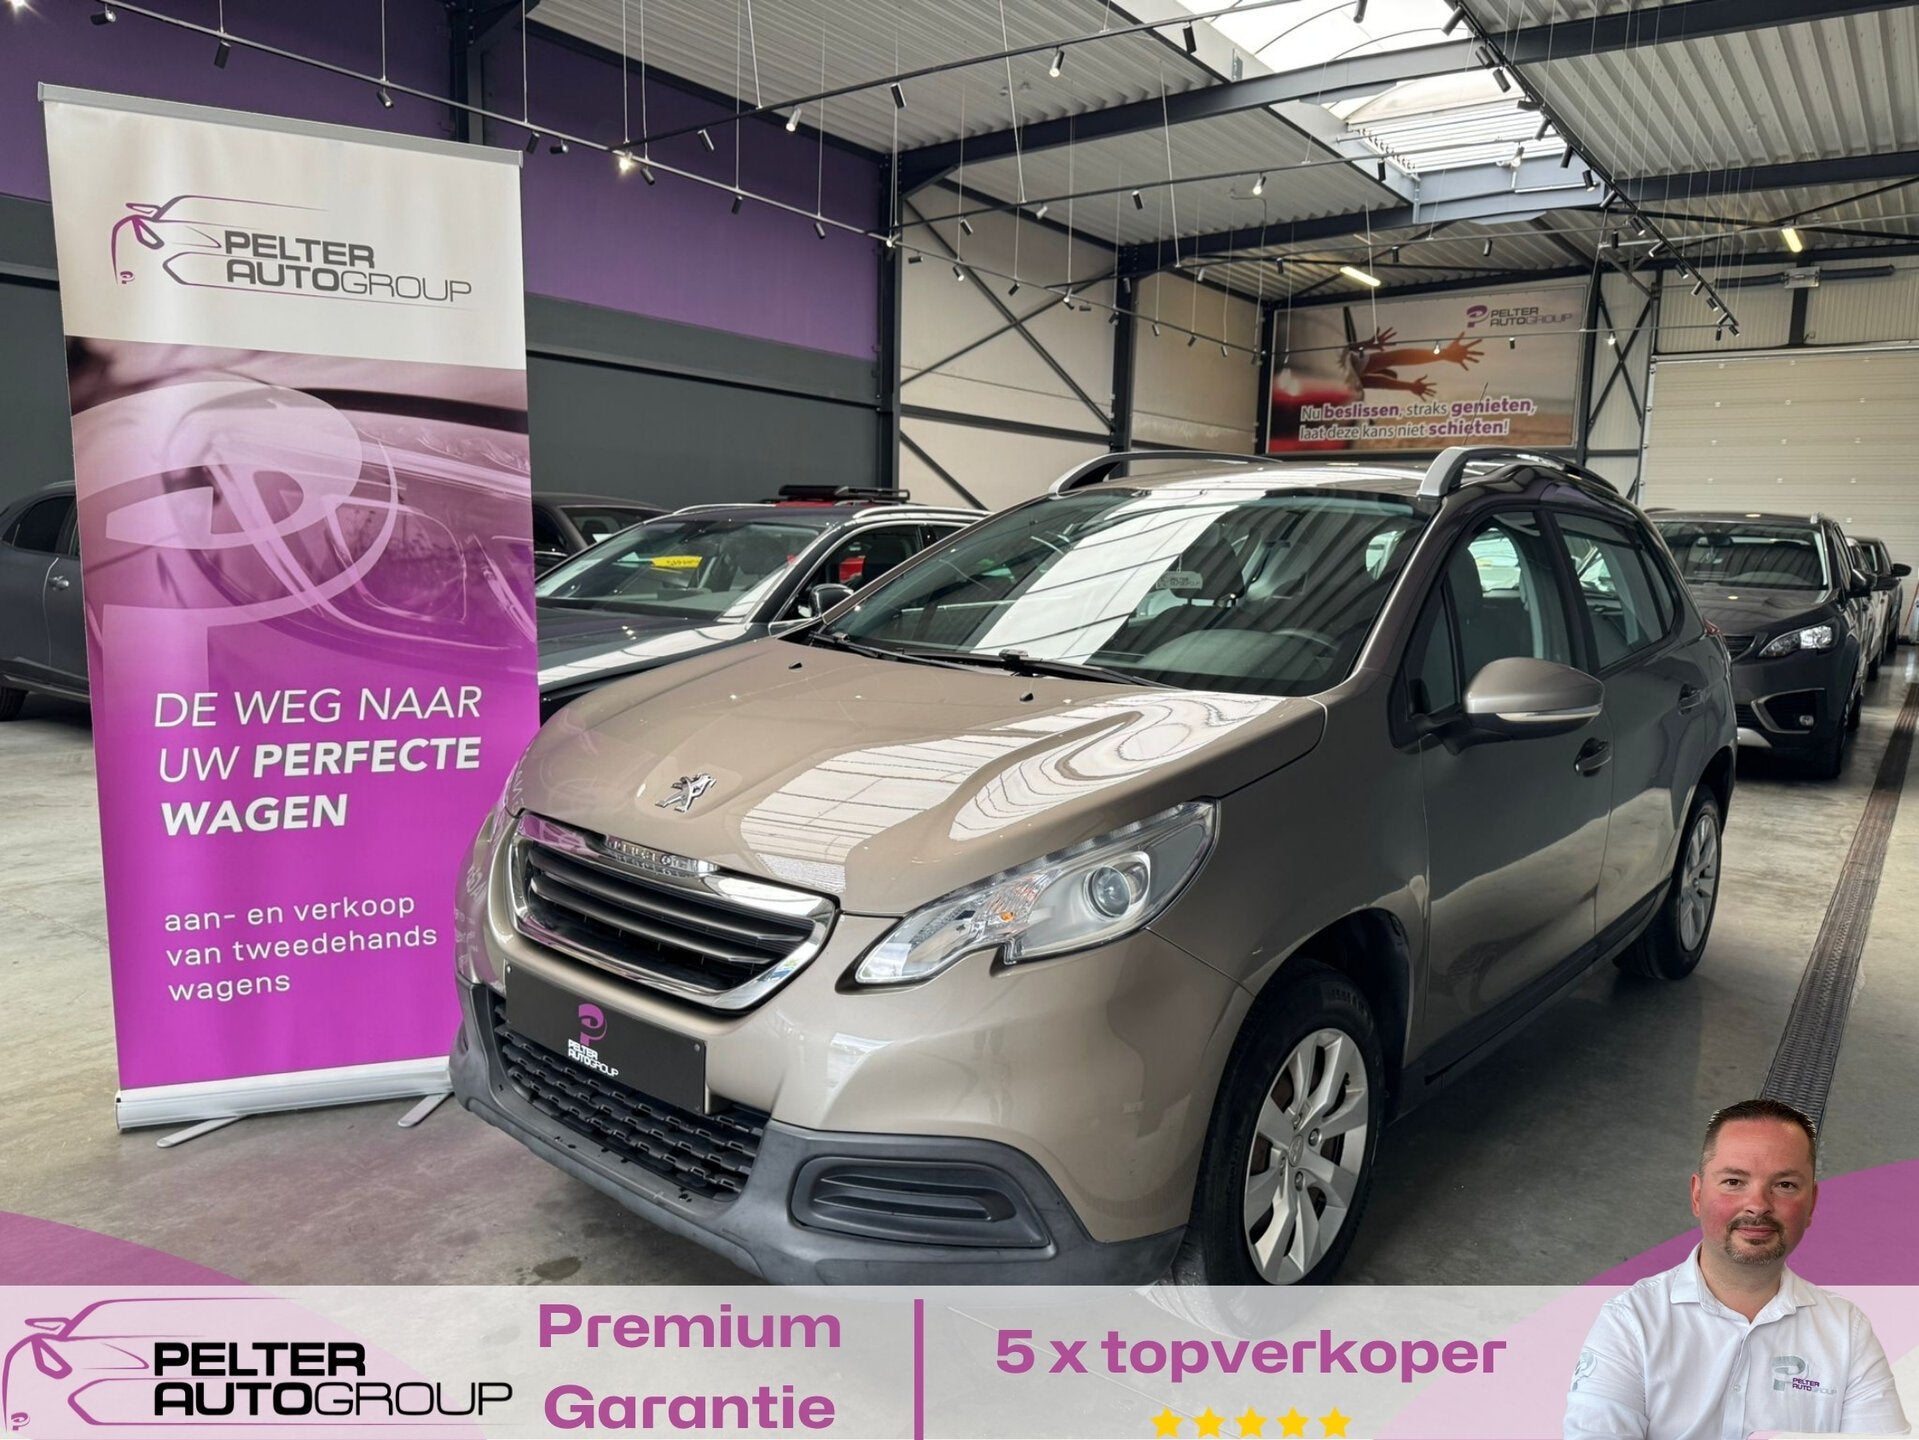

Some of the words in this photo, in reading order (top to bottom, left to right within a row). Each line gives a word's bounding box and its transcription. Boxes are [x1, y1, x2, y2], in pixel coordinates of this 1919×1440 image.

[224, 230, 375, 269] PELTER
[226, 259, 472, 303] AUTOGROUP
[1490, 307, 1539, 318] PELTER
[1490, 313, 1573, 327] AUTOGROUP
[1301, 407, 1320, 420] Nu
[1324, 405, 1402, 420] beslissen,
[1406, 402, 1447, 416] straks
[1451, 398, 1537, 417] genieten,
[1300, 425, 1324, 440] laat
[1328, 424, 1358, 440] deze
[1363, 423, 1394, 438] kans
[1397, 422, 1425, 437] niet
[1429, 420, 1509, 436] schieten!
[154, 691, 219, 728] DE
[233, 688, 341, 726] WEG
[357, 685, 483, 721] NAAR
[159, 745, 241, 783] UW
[253, 736, 482, 779] PERFECTE
[160, 793, 348, 836] WAGEN
[164, 910, 236, 932] aan-
[247, 904, 284, 926] en
[293, 895, 416, 924] verkoop
[166, 946, 222, 967] van
[233, 925, 438, 961] tweedehands
[167, 972, 291, 1003] wagens
[568, 1038, 598, 1060] PELTER
[568, 1048, 619, 1077] AUTOGROUP
[1793, 1378, 1820, 1387] PELTER
